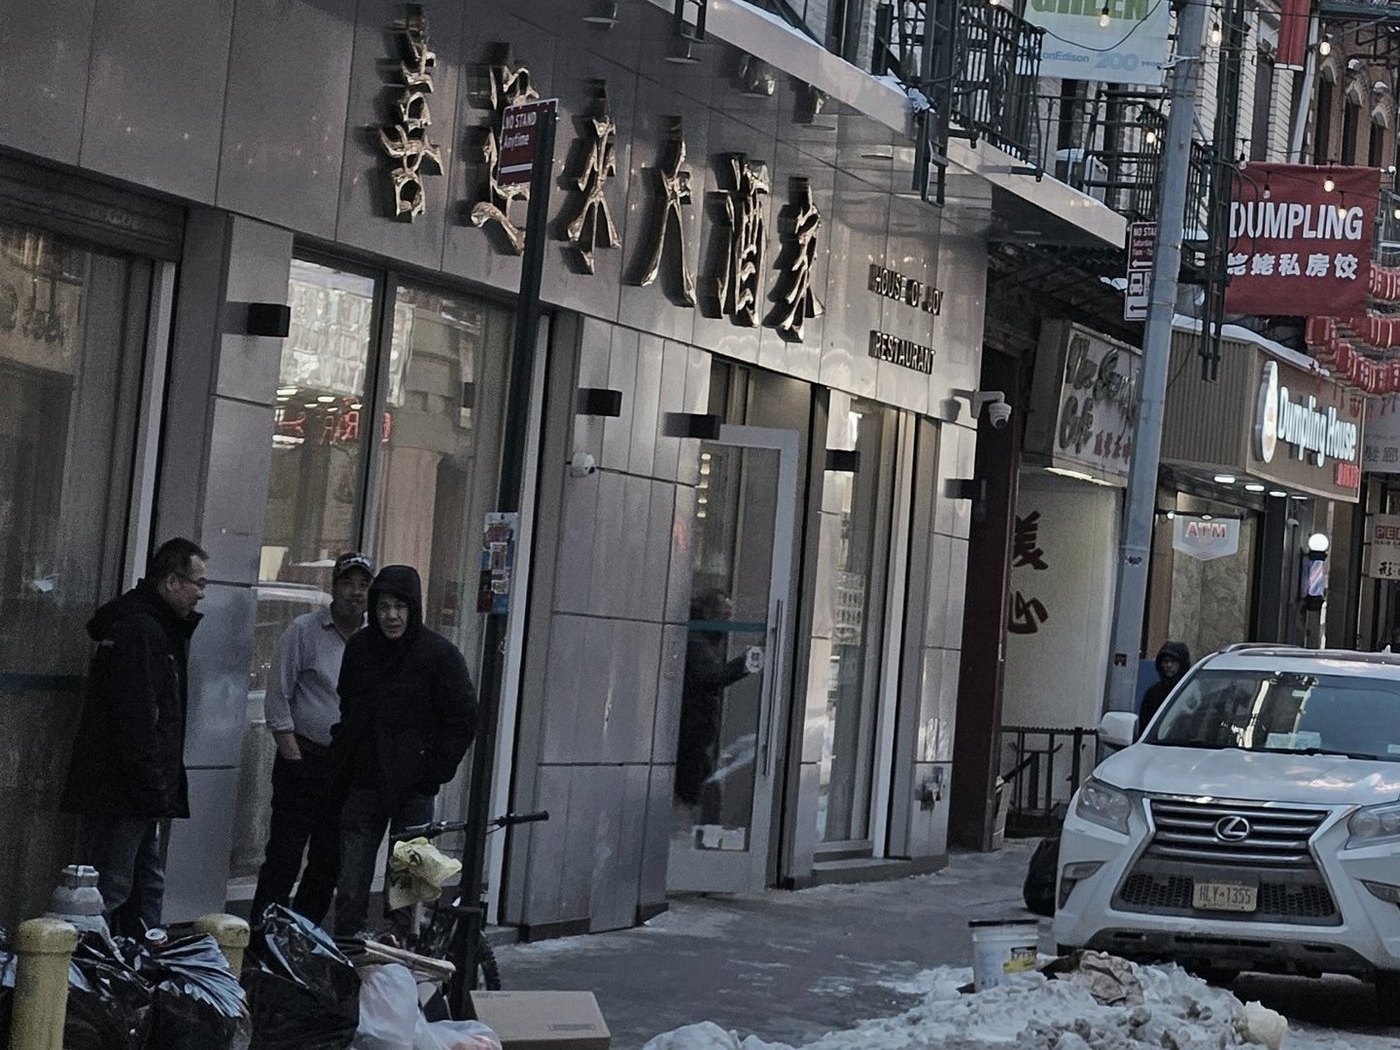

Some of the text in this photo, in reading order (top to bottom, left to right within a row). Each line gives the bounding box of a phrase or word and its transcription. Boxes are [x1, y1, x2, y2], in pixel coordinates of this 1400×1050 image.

[515, 111, 538, 127] STAND
[1229, 201, 1364, 240] DUMPLING
[869, 264, 907, 302] HOUSE
[868, 330, 936, 375] RESTAURANT
[1278, 386, 1357, 467] Dumpling House
[1186, 521, 1228, 540] ATM
